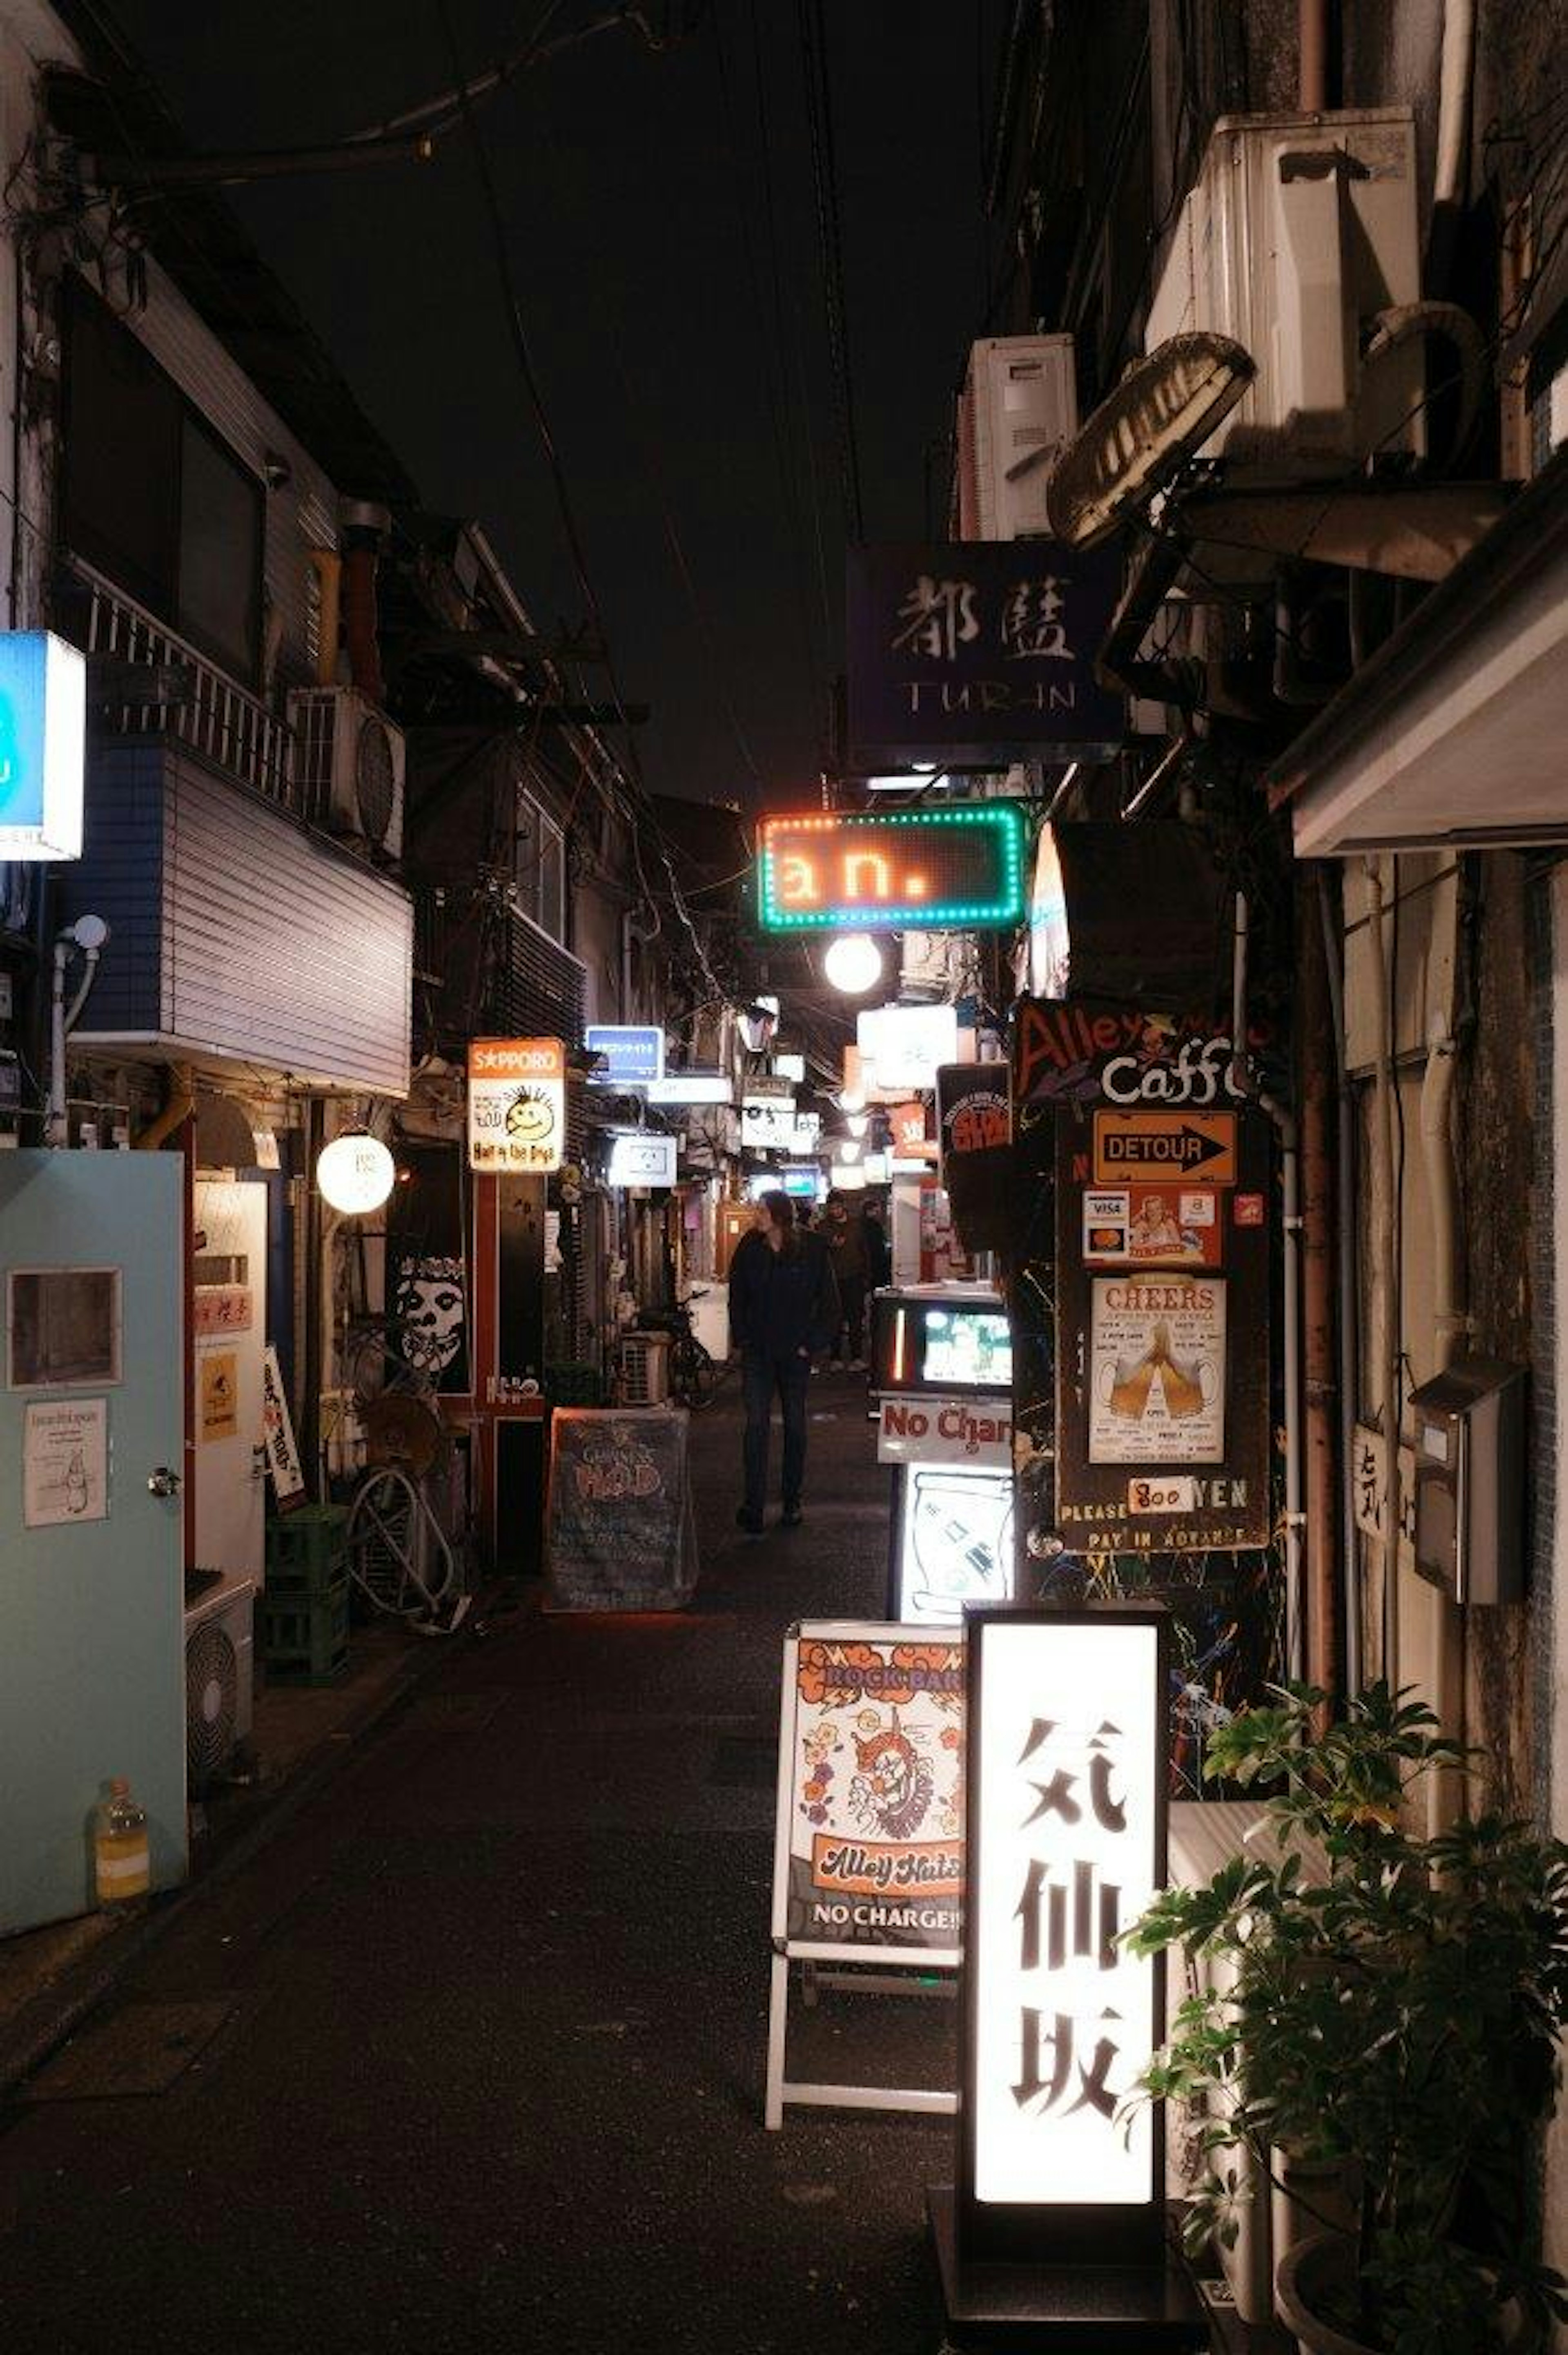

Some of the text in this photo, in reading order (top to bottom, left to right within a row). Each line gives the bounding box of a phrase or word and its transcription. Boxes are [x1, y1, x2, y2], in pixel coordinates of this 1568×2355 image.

[1017, 1005, 1142, 1097] Alley
[1109, 1137, 1202, 1160] DETOUR
[1094, 1203, 1121, 1215] VISA
[1105, 1288, 1215, 1310] CHEERS
[884, 1405, 929, 1437] No
[1135, 1480, 1248, 1508] 800 YEN
[1062, 1503, 1127, 1521] PLEASE
[1088, 1531, 1123, 1549] PAY
[1134, 1531, 1152, 1548] IN
[825, 1665, 963, 1693] ROCK BAR
[821, 1847, 893, 1888] Alley
[813, 1904, 849, 1925] NO
[1011, 1717, 1127, 2121] 気仙坂
